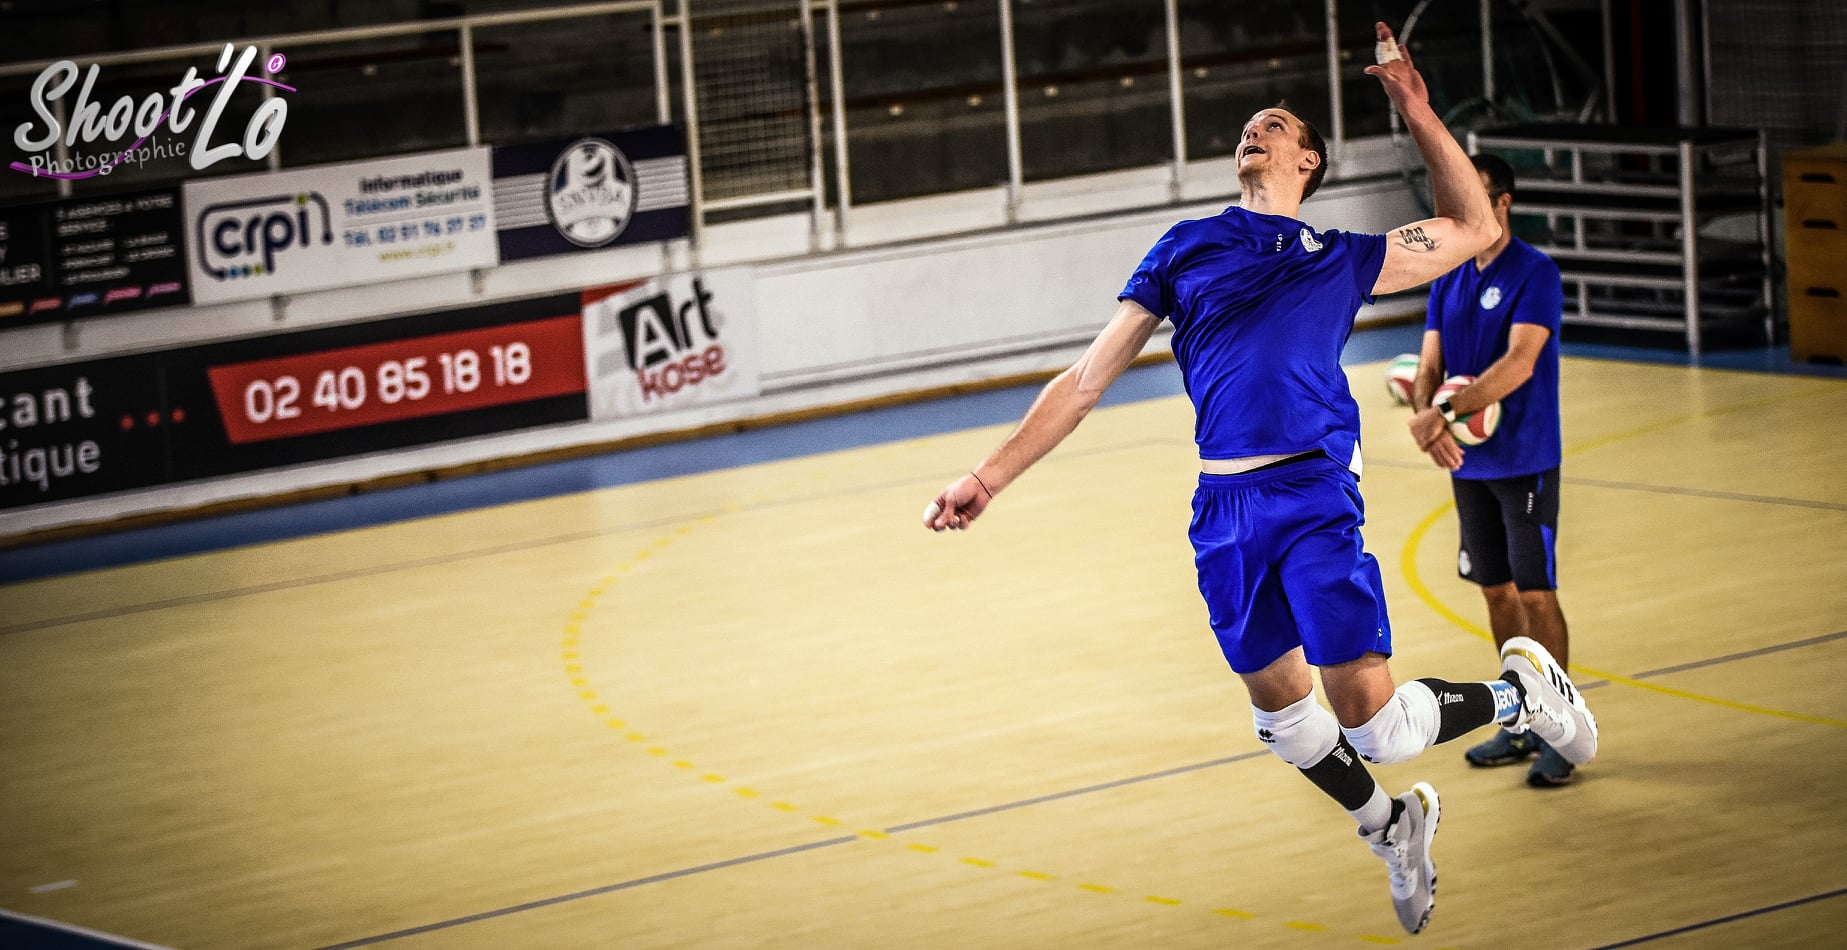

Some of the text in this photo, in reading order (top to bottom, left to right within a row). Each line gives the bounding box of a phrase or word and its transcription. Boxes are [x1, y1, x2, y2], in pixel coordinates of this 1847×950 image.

[358, 170, 464, 194] Informatique
[212, 193, 310, 274] crpi
[632, 278, 718, 373] Art
[244, 342, 532, 424] 02 40 85 18 18
